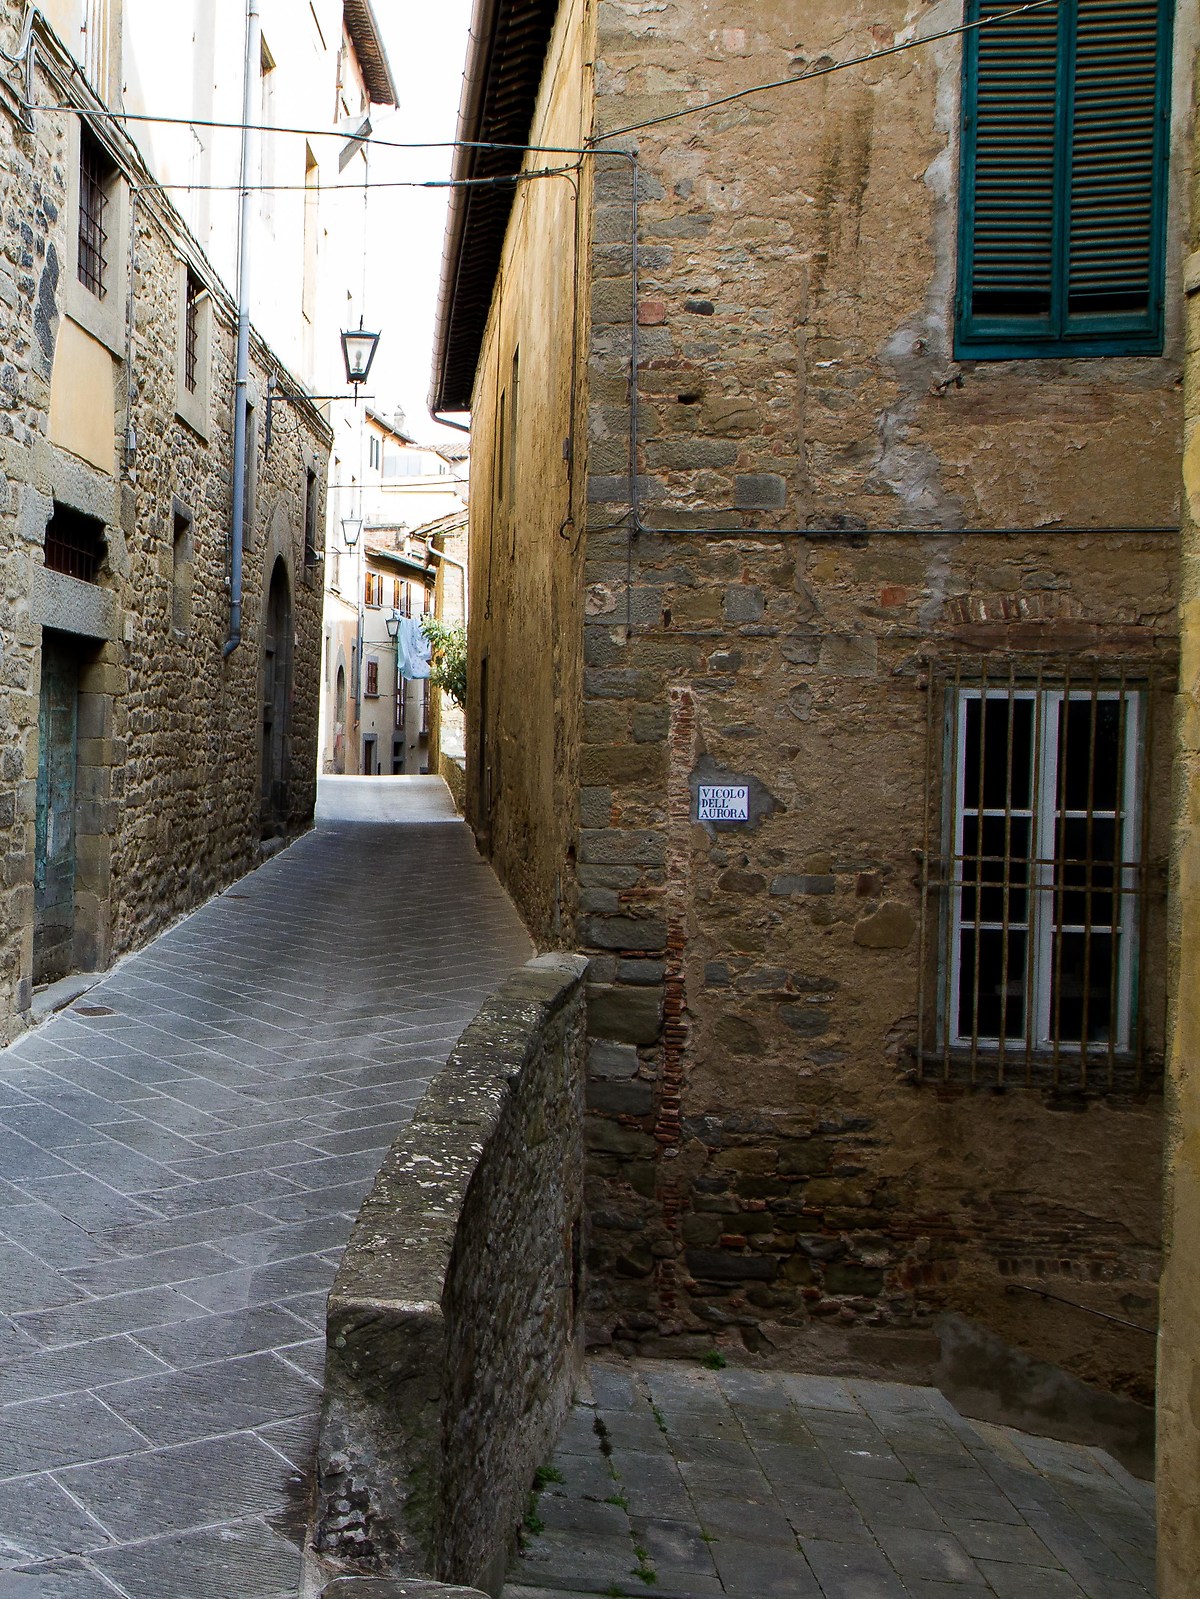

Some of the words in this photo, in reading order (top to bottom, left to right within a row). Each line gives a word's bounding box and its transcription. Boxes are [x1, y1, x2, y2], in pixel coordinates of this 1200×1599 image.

[702, 788, 745, 799] VICOLO
[701, 798, 731, 808] DELL'
[700, 808, 746, 818] AURORA
